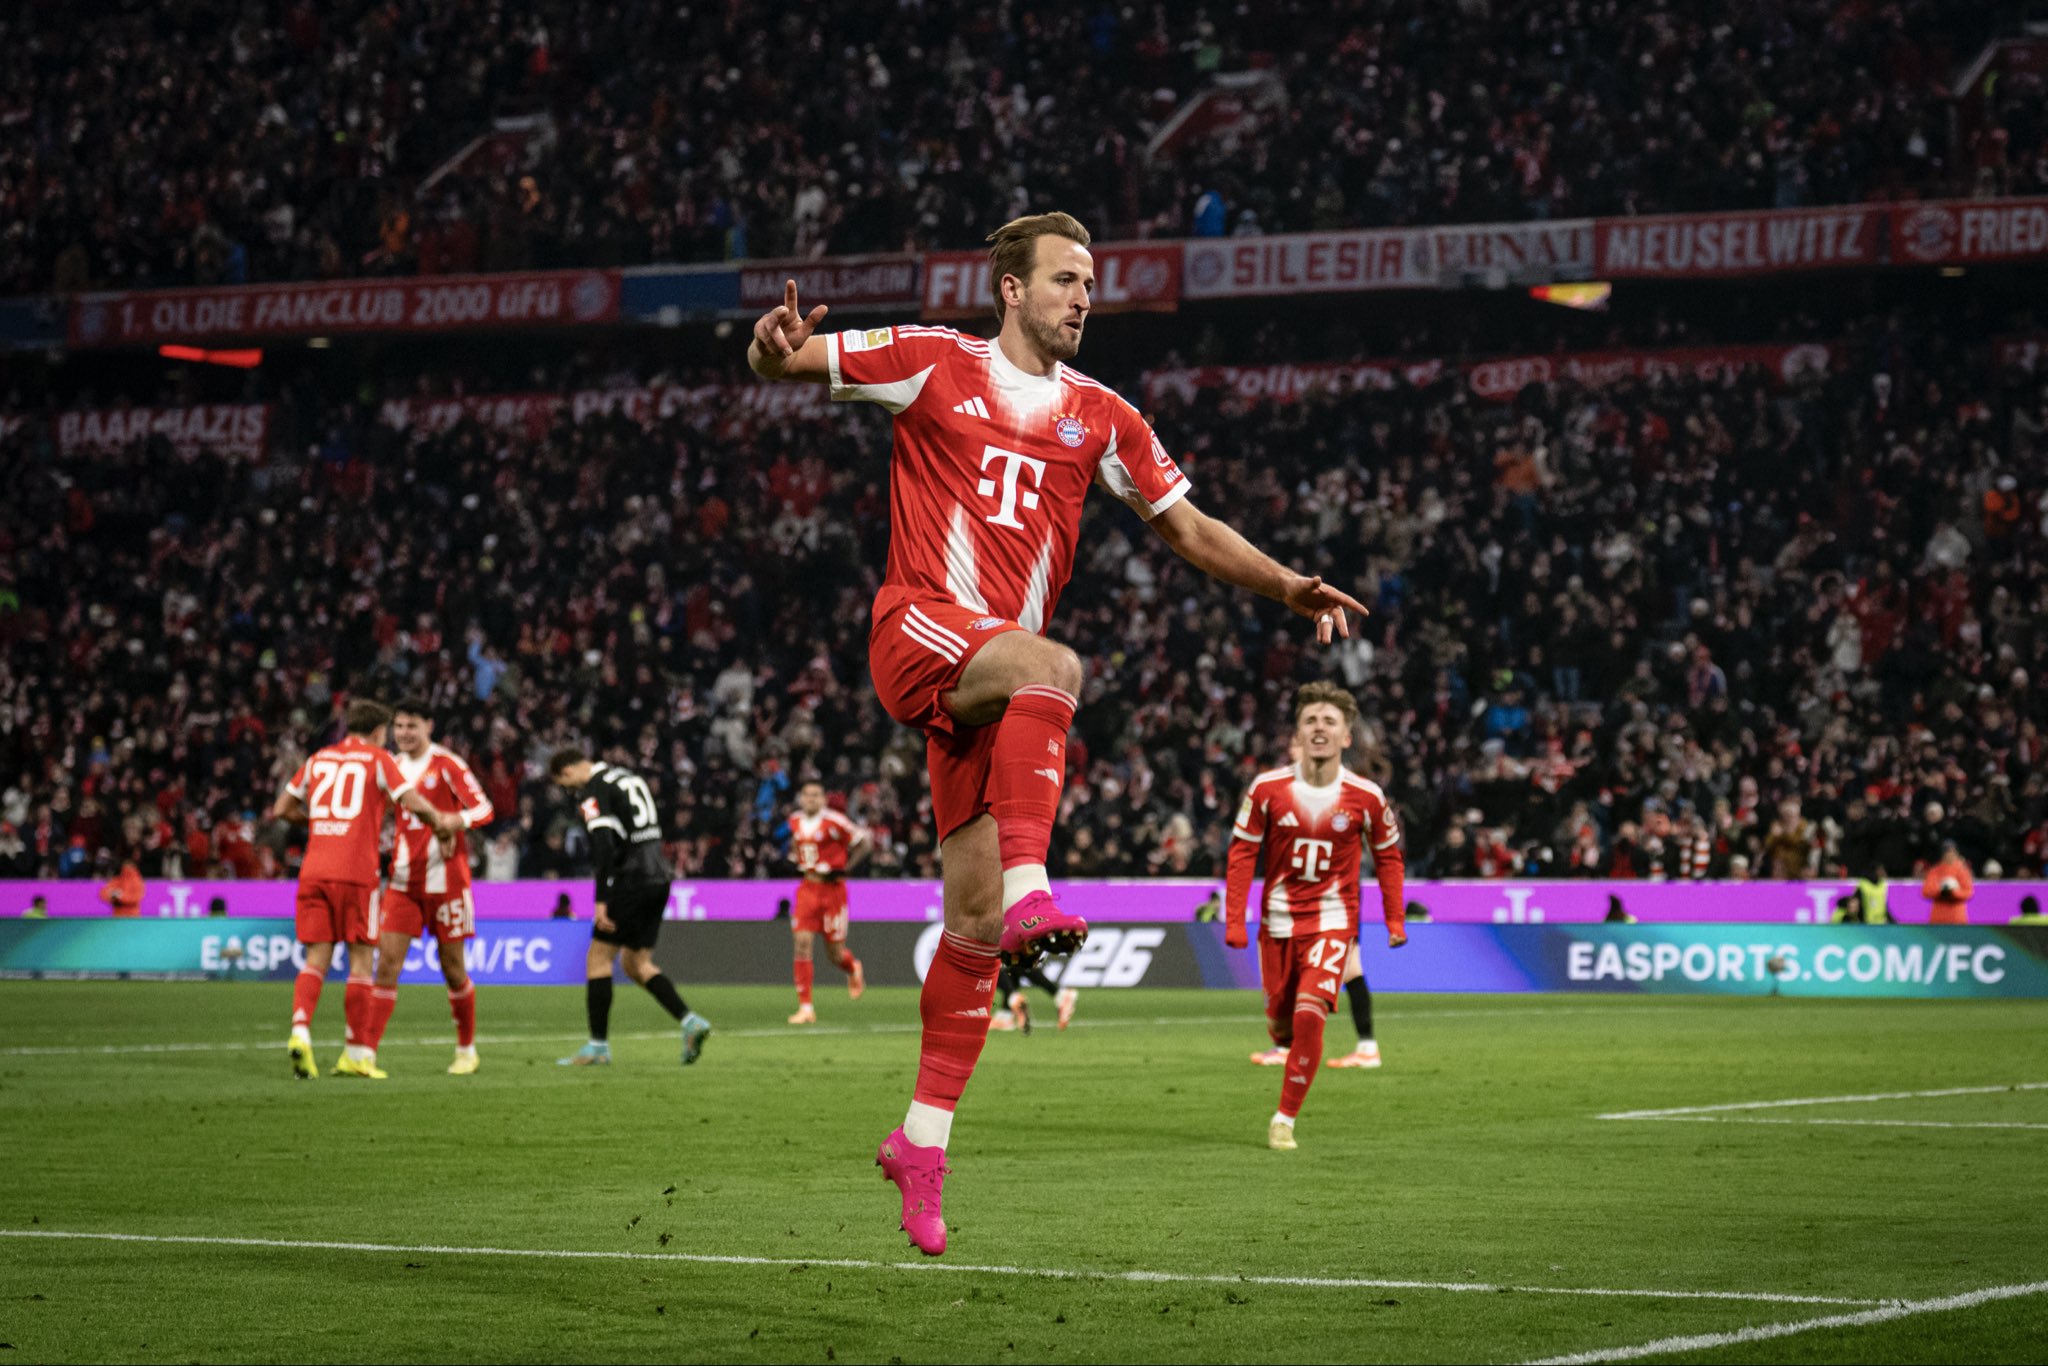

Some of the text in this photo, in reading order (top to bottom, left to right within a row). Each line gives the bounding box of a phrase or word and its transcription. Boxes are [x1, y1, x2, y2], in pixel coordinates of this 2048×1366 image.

[1604, 213, 1866, 271] MEUSELWITZ
[1961, 206, 2048, 256] FRIED
[1233, 239, 1403, 285] SILESIA
[151, 299, 243, 333] OLDIE
[253, 288, 405, 328] FANCLUB
[411, 284, 493, 325] 2000
[977, 445, 1047, 531] T
[309, 761, 367, 820] 20
[1291, 838, 1333, 882] T
[436, 898, 464, 928] 45
[1308, 938, 1347, 975] 42
[1567, 942, 2007, 984] EASPORTS.COM/FC
